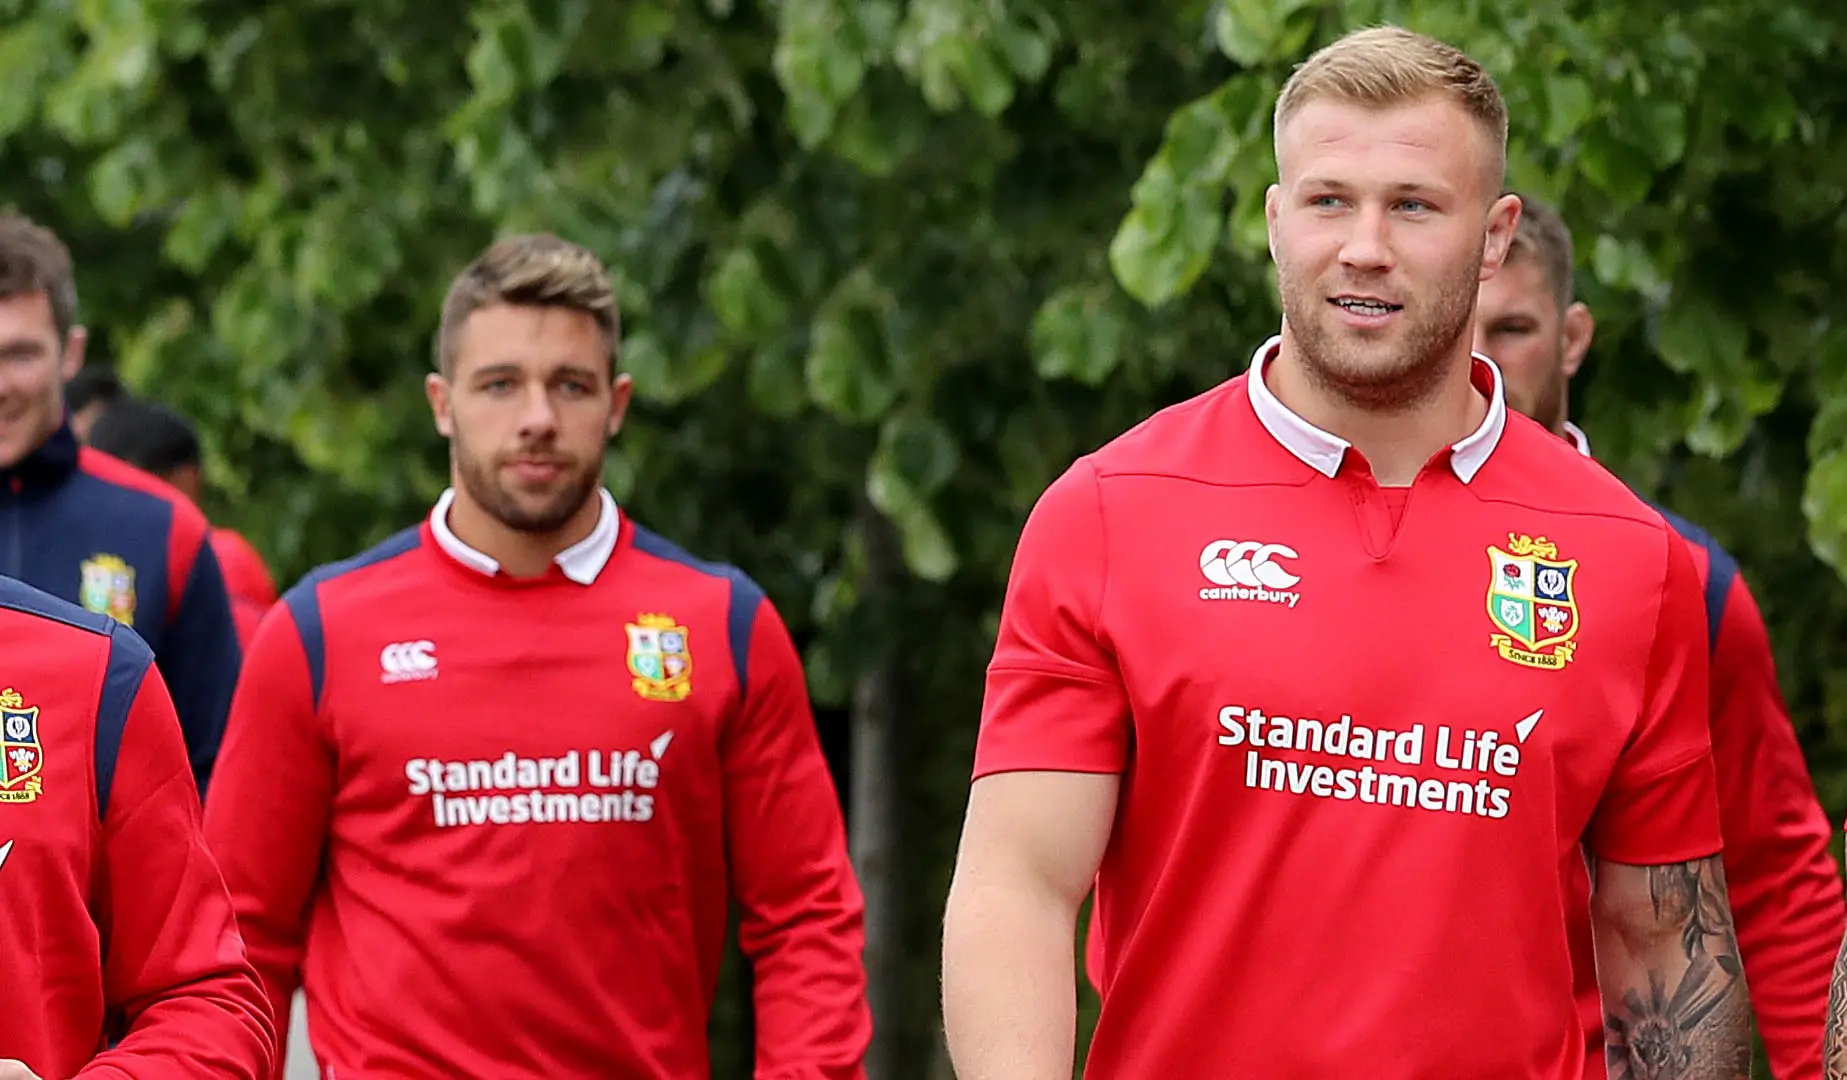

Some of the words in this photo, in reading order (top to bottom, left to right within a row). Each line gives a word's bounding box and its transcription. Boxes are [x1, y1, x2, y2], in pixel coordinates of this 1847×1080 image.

[1199, 585, 1300, 608] canterbury
[1218, 706, 1424, 766] Standard
[1434, 726, 1519, 776] Life
[405, 751, 579, 795] Standard
[587, 750, 659, 788] Life
[1245, 751, 1510, 819] Investments
[433, 790, 654, 827] Investments
